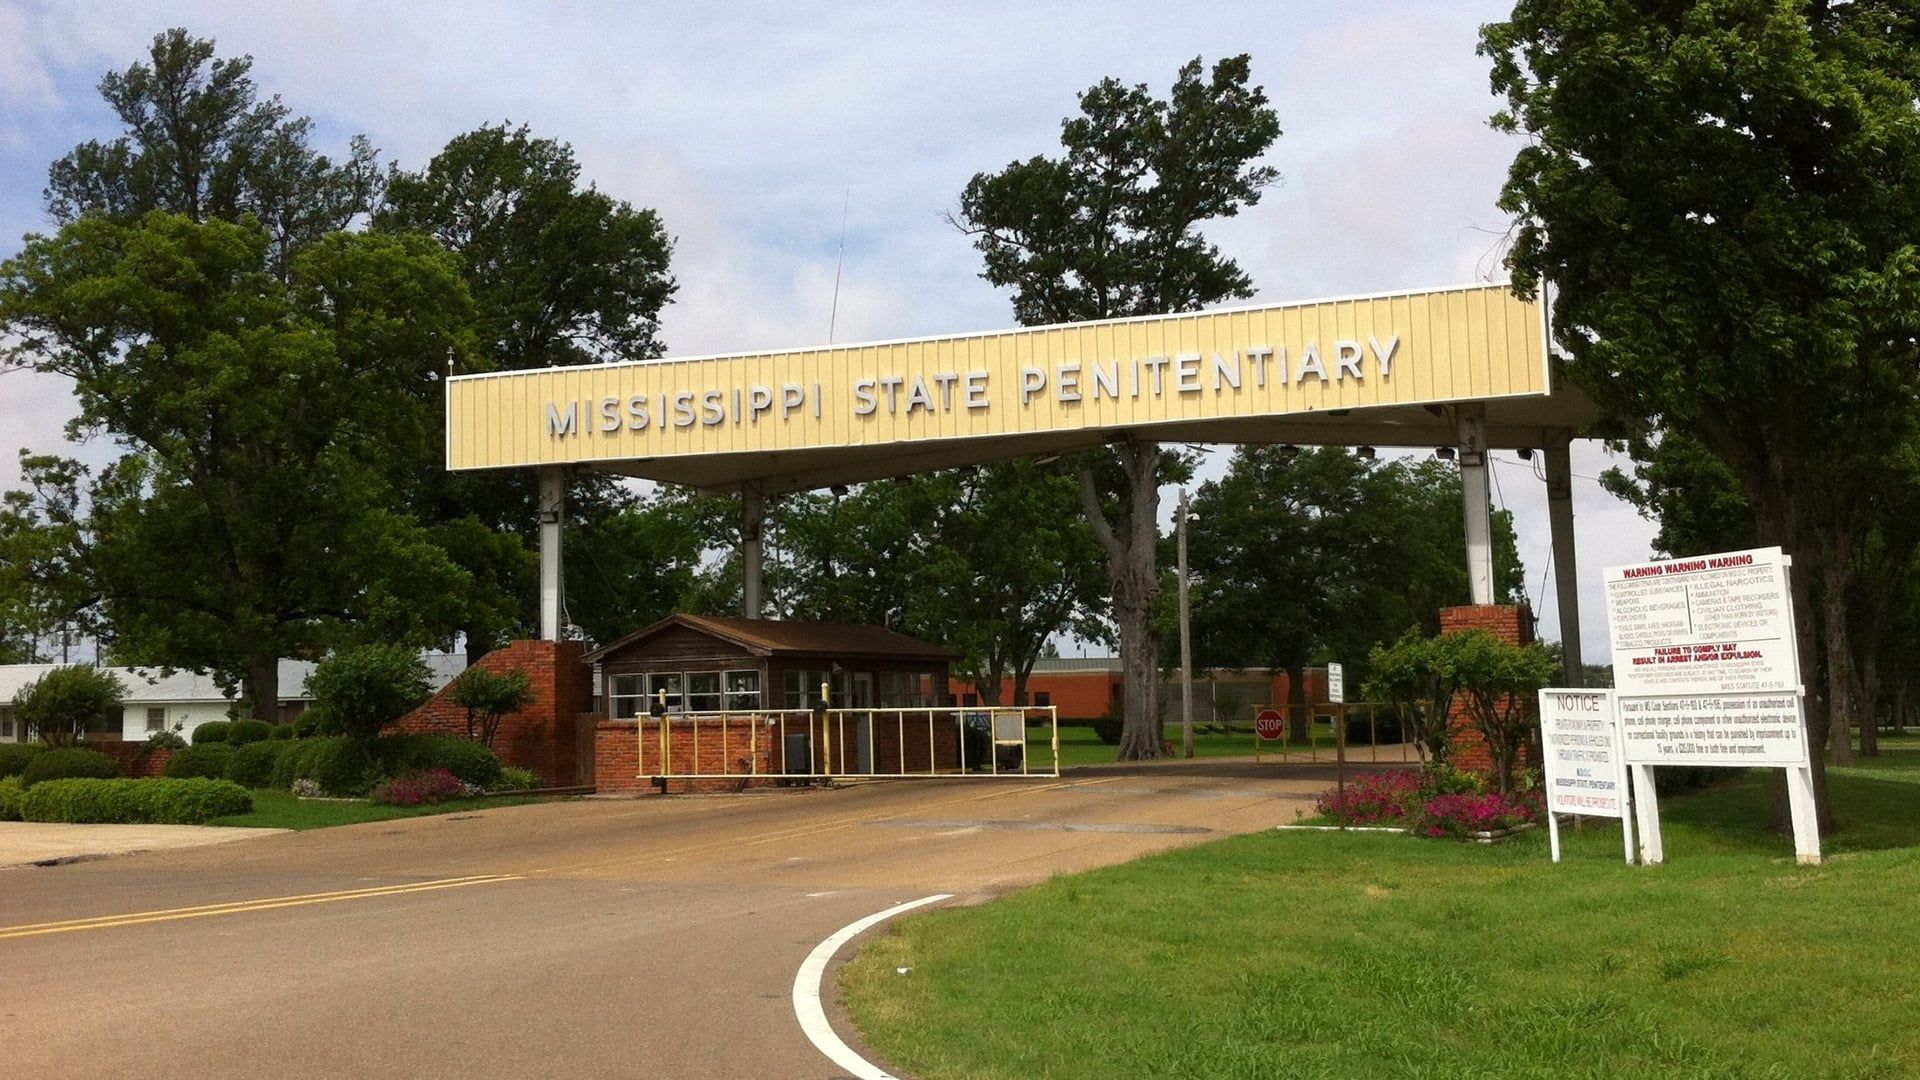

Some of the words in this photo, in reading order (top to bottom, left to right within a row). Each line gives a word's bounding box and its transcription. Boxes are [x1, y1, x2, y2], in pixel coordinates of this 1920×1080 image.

[547, 384, 821, 436] MISSISSIPPI
[855, 371, 989, 415] STATE
[1021, 335, 1400, 404] PENITENTIARY
[1623, 565, 1663, 578] WARNING
[1664, 560, 1706, 574] WARNING
[1708, 554, 1753, 568] WARNING
[1694, 581, 1725, 590] ILLEGAL
[1726, 575, 1774, 586] NARCOTICS
[1616, 604, 1648, 614] ALCOHOLIC
[1649, 601, 1685, 611] BEVERAGES
[1696, 604, 1725, 614] CIVILIAN
[1726, 601, 1763, 612] CLOTHING
[1655, 647, 1681, 656] FAILURE
[1682, 646, 1692, 654] TO
[1693, 644, 1720, 654] COMPLY
[1722, 643, 1737, 651] MAY
[1632, 656, 1656, 665] RESULT
[1657, 656, 1665, 664] IN
[1667, 654, 1692, 663] ARREST
[1557, 694, 1599, 712] NOTICE
[1258, 719, 1281, 730] STOP
